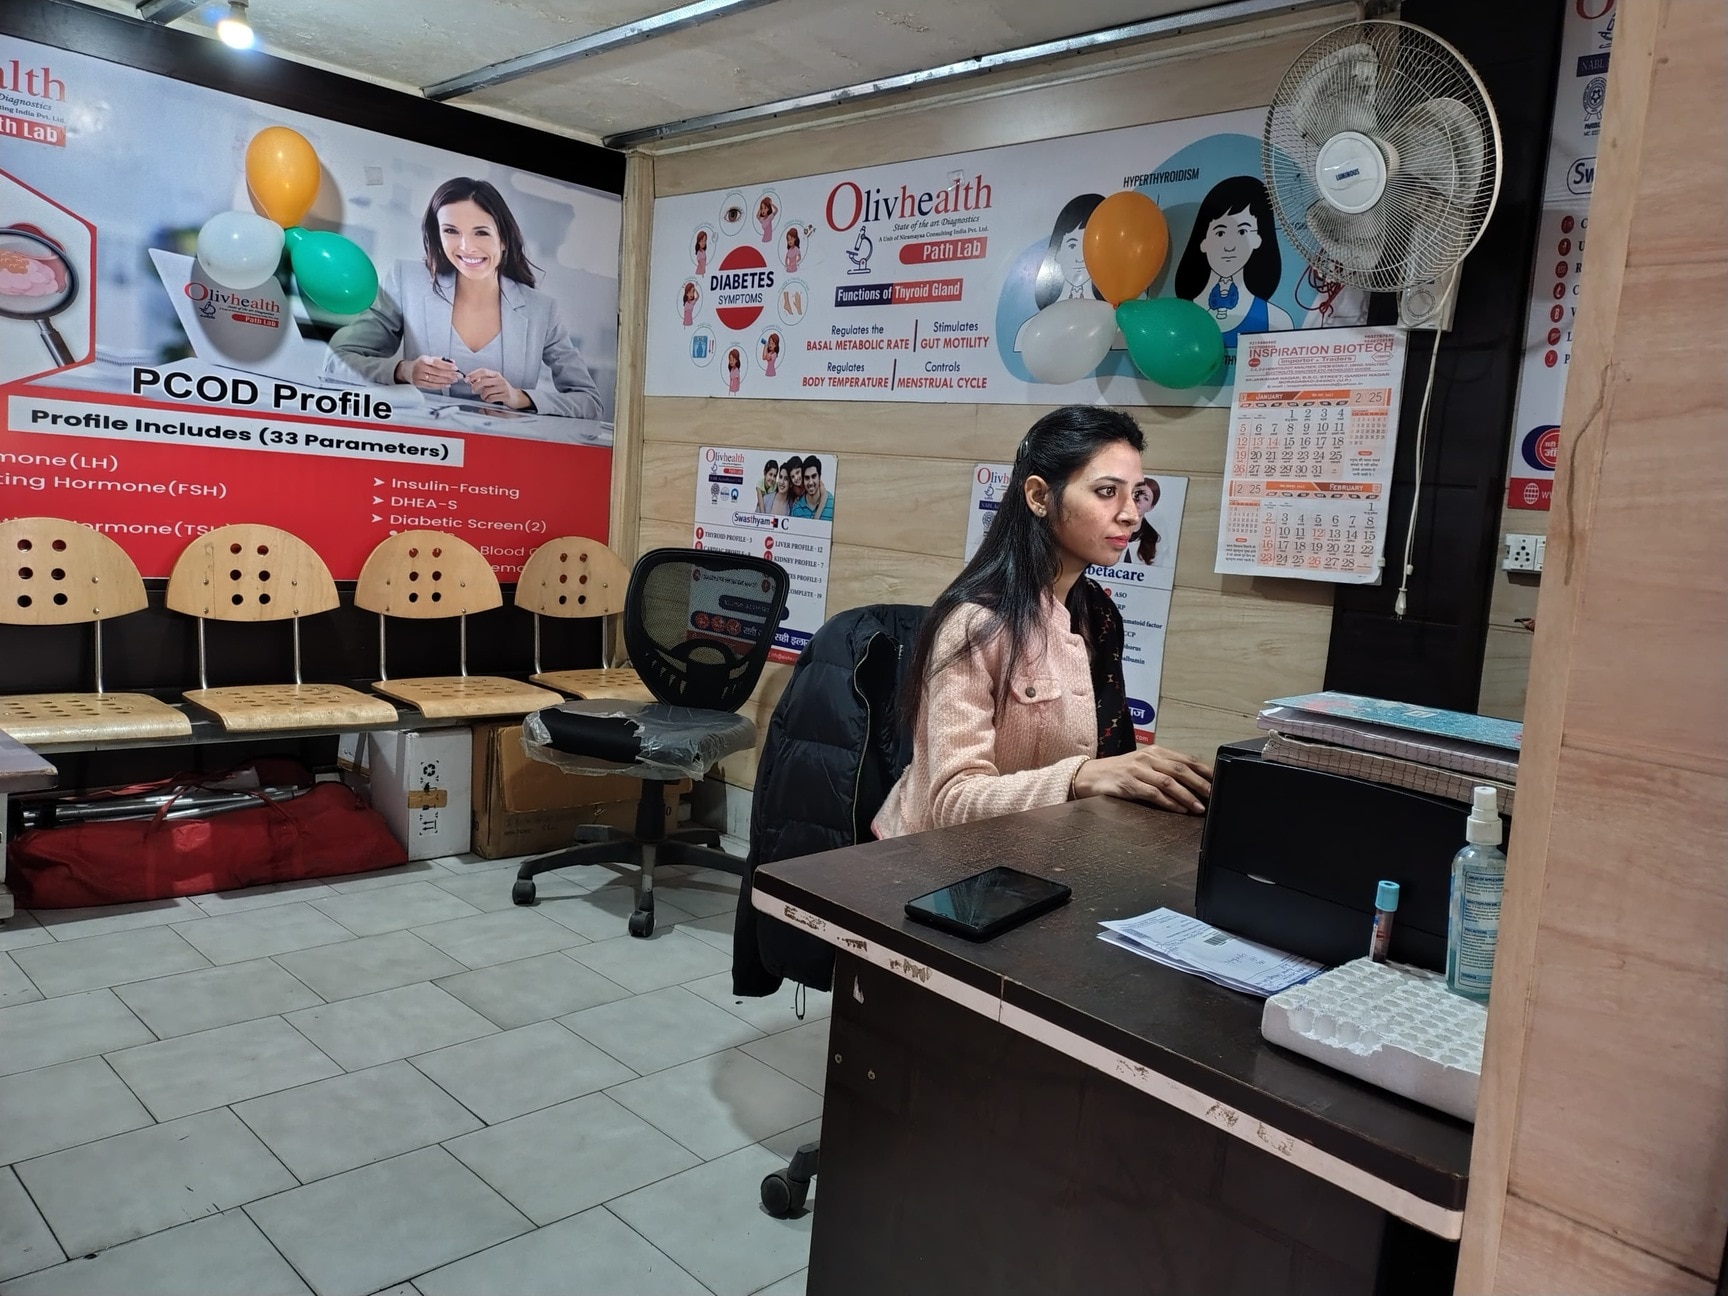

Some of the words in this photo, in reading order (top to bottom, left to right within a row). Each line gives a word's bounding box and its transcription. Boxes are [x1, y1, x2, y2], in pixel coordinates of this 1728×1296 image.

[23, 122, 58, 143] Lab
[1123, 167, 1200, 188] HYPERTHYROIDISM
[825, 174, 992, 232] Olivhealth
[893, 224, 909, 232] State
[910, 222, 917, 231] of
[918, 220, 929, 228] the
[929, 219, 940, 227] art
[941, 215, 980, 227] Diagnostics
[923, 243, 953, 261] Path
[956, 240, 981, 258] Lab
[710, 270, 775, 291] DIABETES
[184, 282, 281, 313] Olivhealth
[718, 292, 763, 305] SYMPTOMS
[837, 287, 881, 302] Functions
[882, 286, 892, 300] of
[894, 283, 930, 301] Thyroid
[932, 282, 960, 297] Gland
[831, 325, 869, 338] Regulates
[871, 324, 885, 334] the
[933, 321, 979, 333] Stimulates
[806, 340, 833, 351] BASAL
[834, 339, 885, 351] METABOLIC
[886, 338, 910, 350] RATE
[920, 337, 941, 349] GUT
[942, 336, 990, 349] MOTILITY
[1249, 345, 1329, 358] INSPIRATION
[1333, 342, 1394, 355] BIOTECH
[827, 361, 865, 374] Regulates
[925, 360, 961, 373] Controls
[802, 377, 826, 387] BODY
[827, 377, 889, 388] TEMPERATURE
[897, 377, 954, 389] MENSTRUAL
[956, 377, 988, 389] CYCLE
[132, 367, 258, 405] PCOD
[273, 383, 393, 420] Profile
[1256, 393, 1284, 401] JANUARY
[1289, 410, 1294, 419] 1
[1305, 409, 1312, 418] 2
[1320, 409, 1327, 418] 3
[1337, 408, 1344, 418] 4
[1240, 423, 1246, 432] 5
[1255, 423, 1262, 432] 6
[1272, 424, 1278, 432] 7
[1287, 424, 1294, 432] 8
[1303, 423, 1310, 432] 9
[1317, 423, 1329, 432] 10
[1334, 422, 1344, 432] 11
[31, 409, 128, 431] Profile
[136, 418, 252, 441] Includes
[259, 427, 298, 446] (33
[304, 434, 449, 461] Parameters)
[1237, 437, 1248, 446] 12
[1252, 437, 1263, 446] 13
[1268, 438, 1279, 446] 14
[1284, 438, 1295, 446] 15
[1300, 437, 1311, 446] 16
[1316, 437, 1327, 446] 17
[1333, 437, 1344, 446] 18
[706, 448, 745, 463] Olivhealth
[1236, 451, 1247, 460] 19
[1250, 451, 1262, 460] 20
[1266, 451, 1277, 460] 21
[1282, 451, 1294, 460] 22
[1297, 451, 1309, 460] 23
[1313, 451, 1325, 460] 24
[1329, 451, 1343, 460] 25
[1233, 464, 1246, 473] 26
[1249, 464, 1260, 474] 27
[1264, 464, 1276, 474] 28
[1280, 464, 1292, 474] 29
[1296, 465, 1308, 474] 30
[1312, 465, 1323, 474] 31
[54, 476, 227, 499] Hormone(FSH)
[392, 478, 520, 499] Insulin-Fasting
[391, 496, 458, 511] DHEA-S
[1369, 502, 1374, 512] 1
[390, 514, 462, 529] Diabetic
[468, 517, 547, 535] Screen(2)
[734, 513, 771, 527] Swasthyam
[781, 518, 789, 531] C
[1266, 512, 1273, 521] 2
[1282, 513, 1289, 522] 3
[1298, 514, 1304, 522] 4
[1315, 514, 1322, 524] 5
[1332, 515, 1339, 524] 6
[1349, 516, 1356, 525] 7
[1366, 516, 1374, 525] 8
[705, 532, 726, 540] THYROID
[726, 534, 746, 543] PROFILE
[1265, 527, 1271, 535] 9
[1279, 527, 1291, 536] 10
[1295, 528, 1305, 536] 11
[1312, 529, 1324, 537] 12
[1329, 529, 1341, 538] 13
[1346, 530, 1358, 540] 14
[1363, 531, 1375, 540] 15
[480, 545, 525, 557] Blood
[775, 540, 791, 549] LIVER
[791, 542, 814, 552] PROFILE
[1262, 540, 1273, 549] 16
[1278, 541, 1290, 550] 17
[1294, 541, 1306, 550] 18
[1311, 542, 1323, 551] 19
[1327, 543, 1340, 552] 20
[1344, 544, 1355, 553] 21
[1361, 545, 1374, 554] 22
[774, 556, 794, 565] KIDNEY
[794, 559, 817, 568] PROFILE
[1260, 553, 1273, 562] 23
[1276, 554, 1288, 563] 24
[1292, 555, 1304, 564] 25
[1308, 555, 1322, 564] 26
[1325, 557, 1338, 566] 27
[1342, 558, 1355, 568] 28
[1085, 565, 1145, 582] betacare
[1146, 620, 1163, 629] factor
